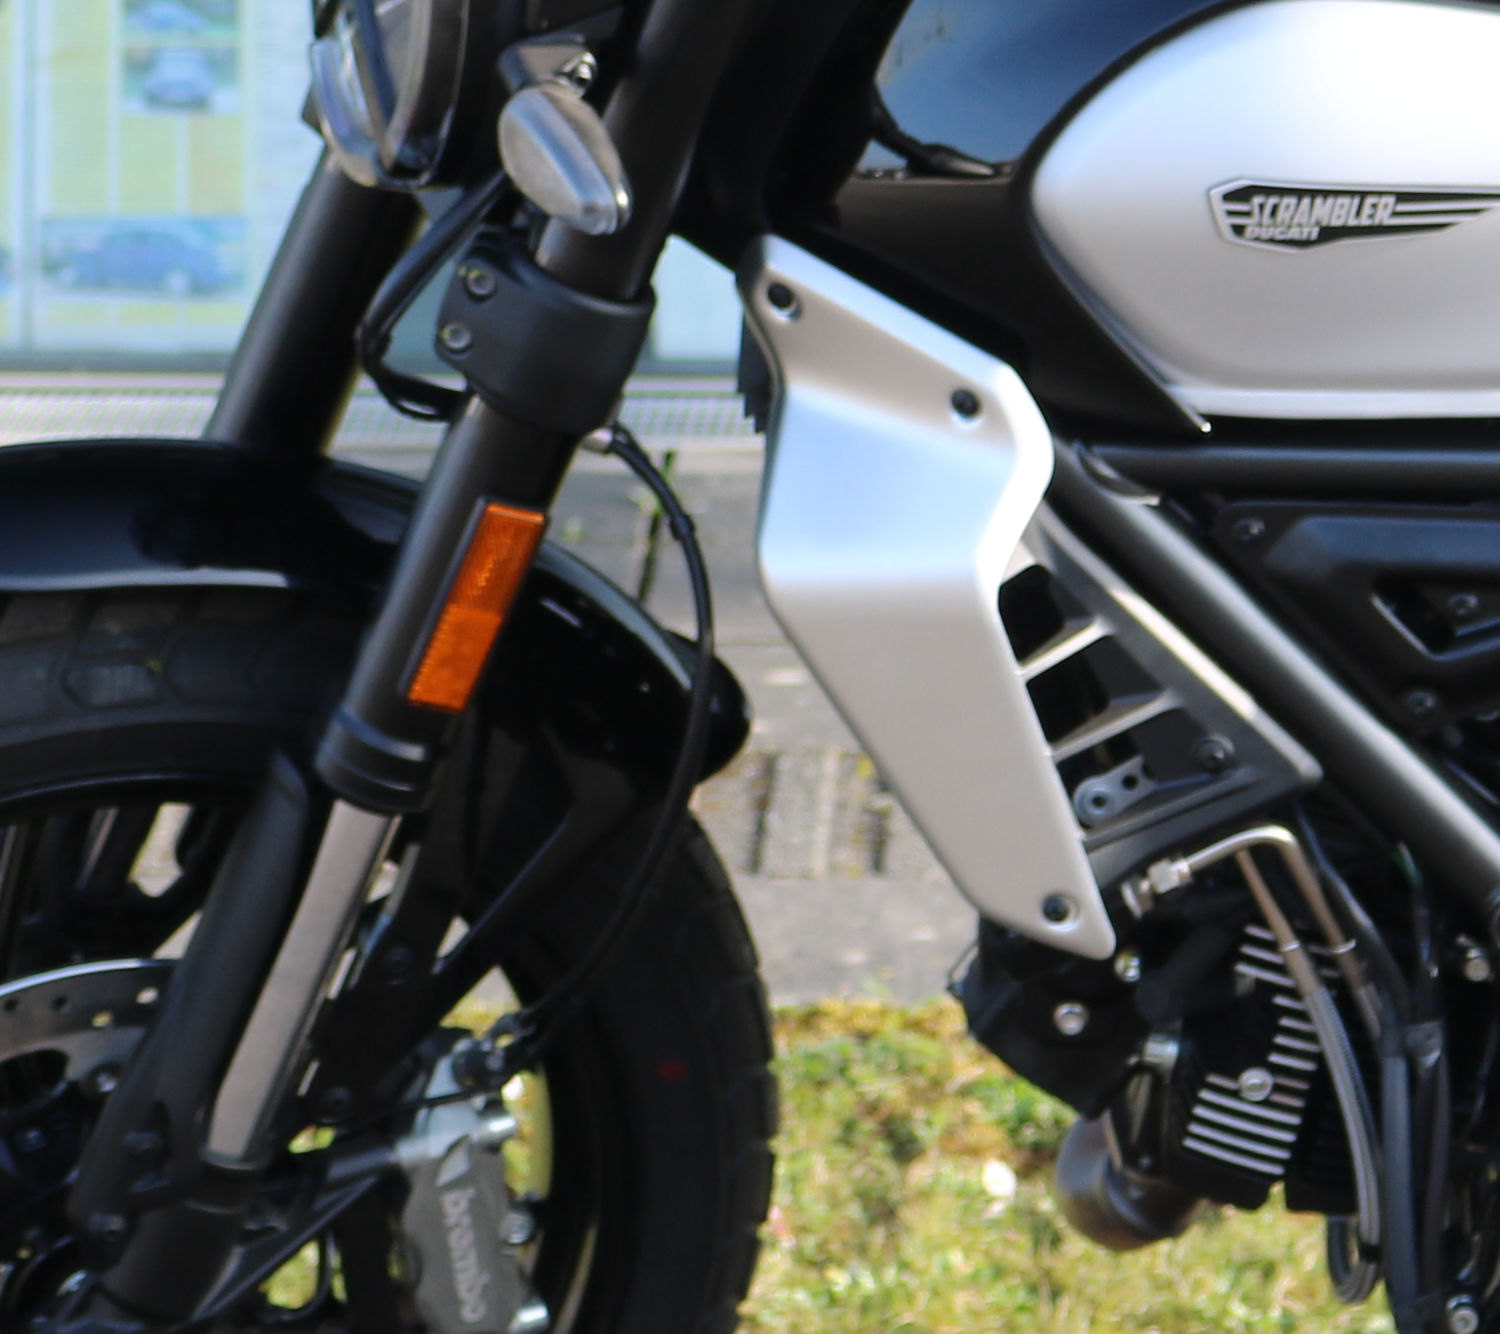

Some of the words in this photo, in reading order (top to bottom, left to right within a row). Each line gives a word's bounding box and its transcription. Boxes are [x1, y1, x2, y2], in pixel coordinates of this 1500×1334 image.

[1250, 194, 1398, 228] SCRAMBLER
[1243, 225, 1321, 242] DUCATI
[441, 1186, 491, 1323] brembo
